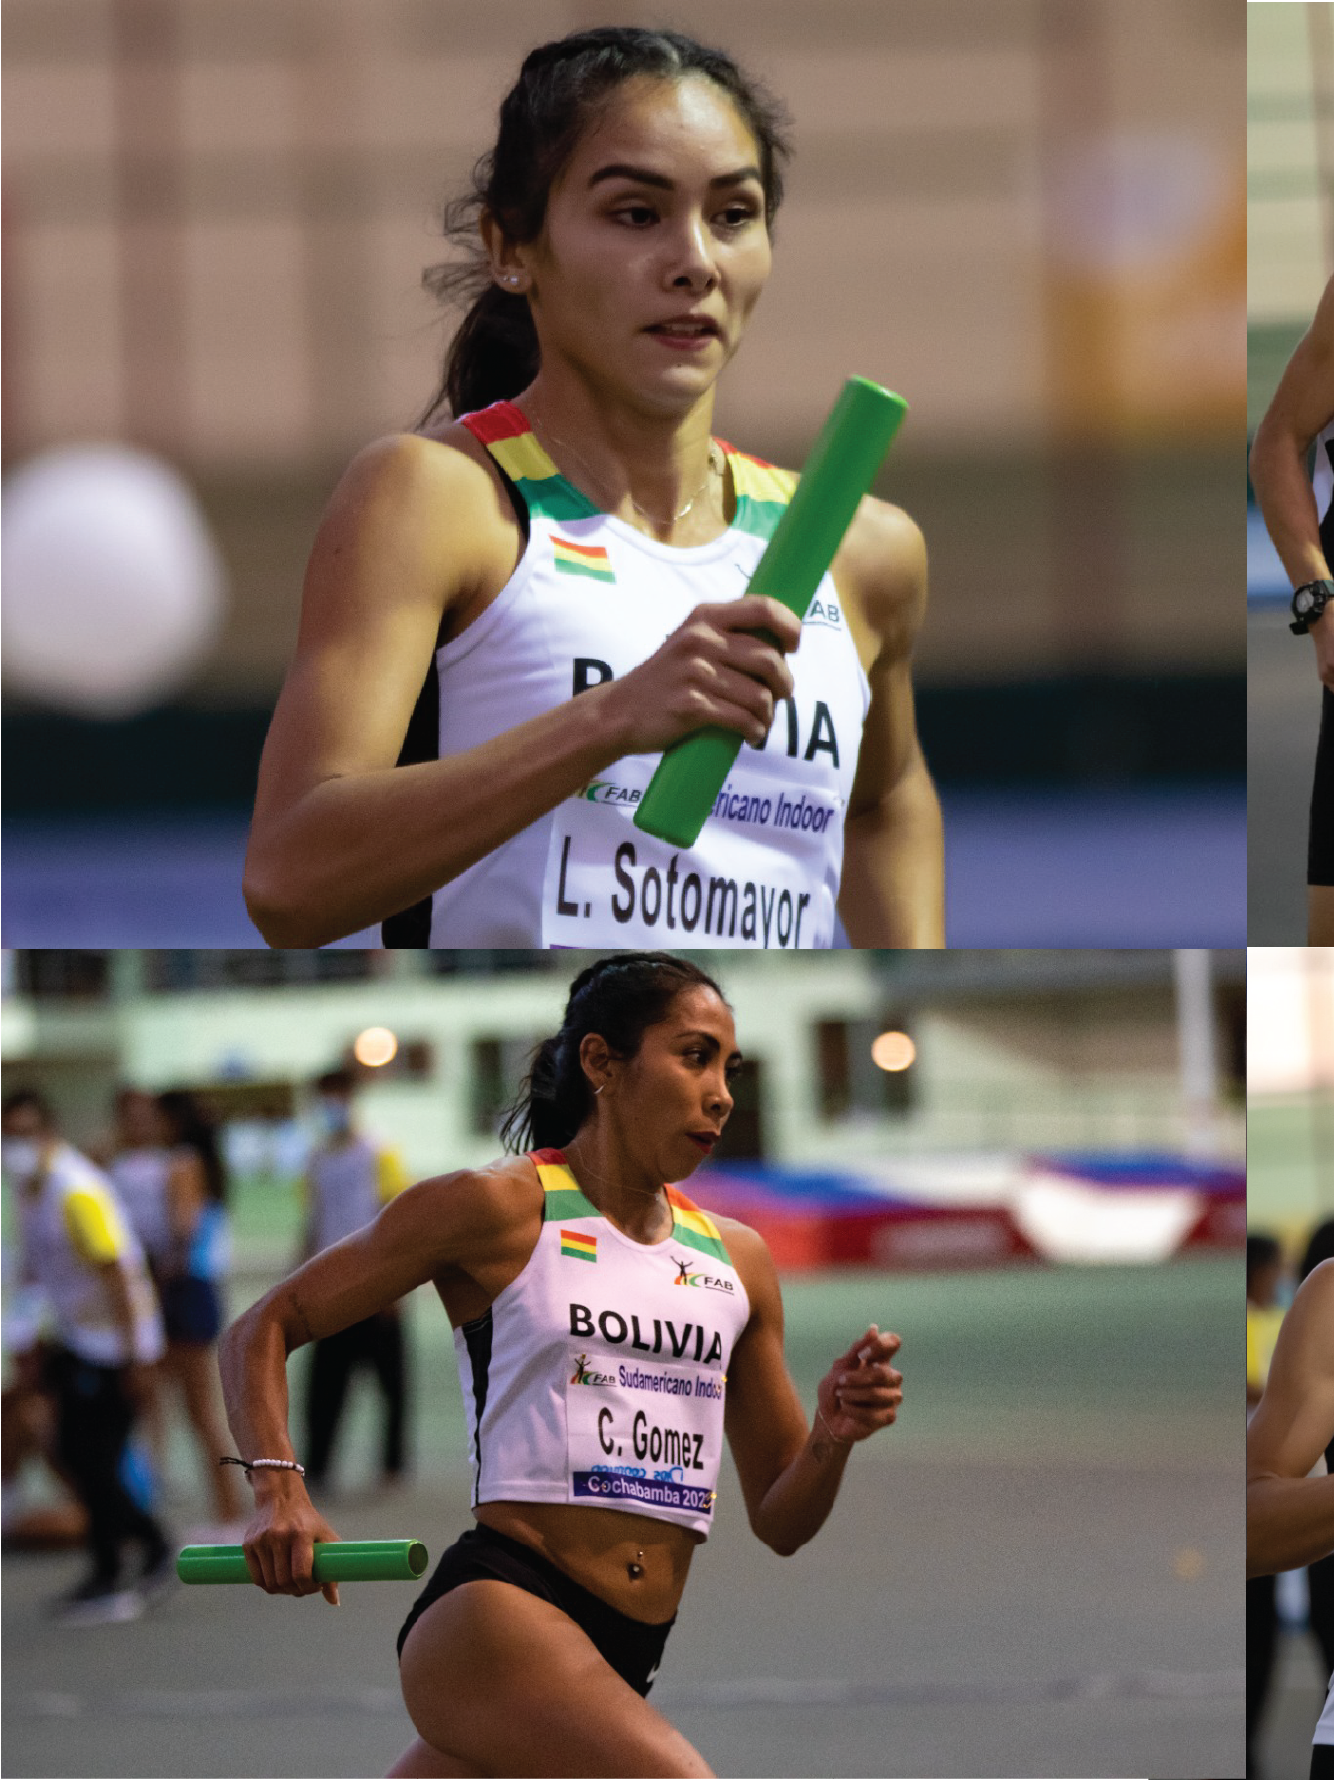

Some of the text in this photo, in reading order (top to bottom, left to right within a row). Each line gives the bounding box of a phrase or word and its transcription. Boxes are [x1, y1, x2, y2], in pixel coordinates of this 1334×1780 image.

[810, 599, 840, 623] AB
[605, 786, 642, 803] FAB
[773, 792, 834, 833] Indoor
[556, 835, 811, 949] L. Sotomayor
[704, 1276, 733, 1291] FAB
[569, 1303, 722, 1365] BOLIVIA
[593, 1374, 616, 1384] FAB
[619, 1365, 691, 1397] Sudamericano
[598, 1406, 704, 1470] C. Gomez
[588, 1476, 680, 1504] Cochabamba
